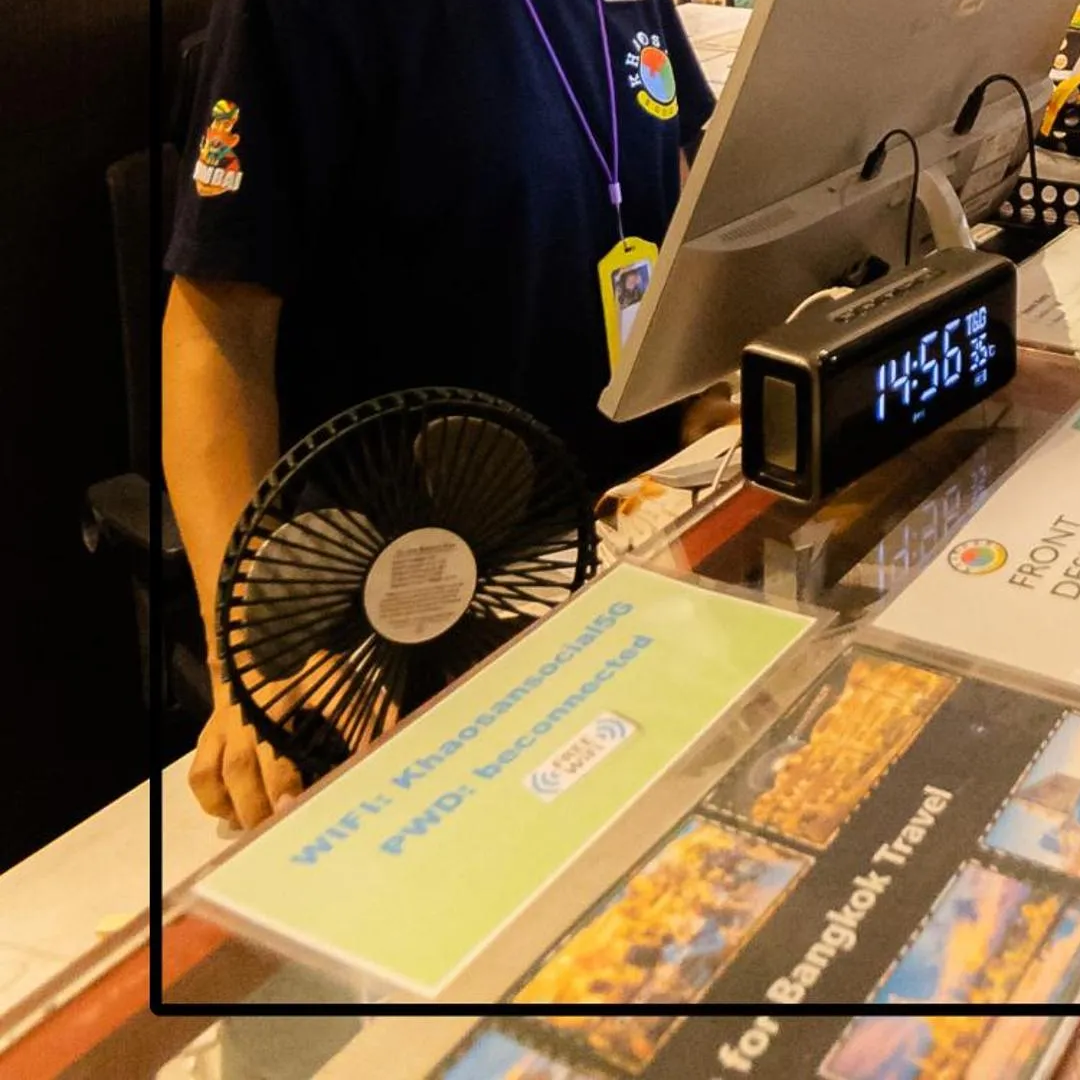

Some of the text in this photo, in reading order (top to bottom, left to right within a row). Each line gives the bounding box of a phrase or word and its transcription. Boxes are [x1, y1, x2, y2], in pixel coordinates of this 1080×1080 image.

[876, 318, 962, 422] 14:56
[380, 633, 656, 856] PWD: beconnected
[717, 783, 954, 1073] for Bangkok Travel
